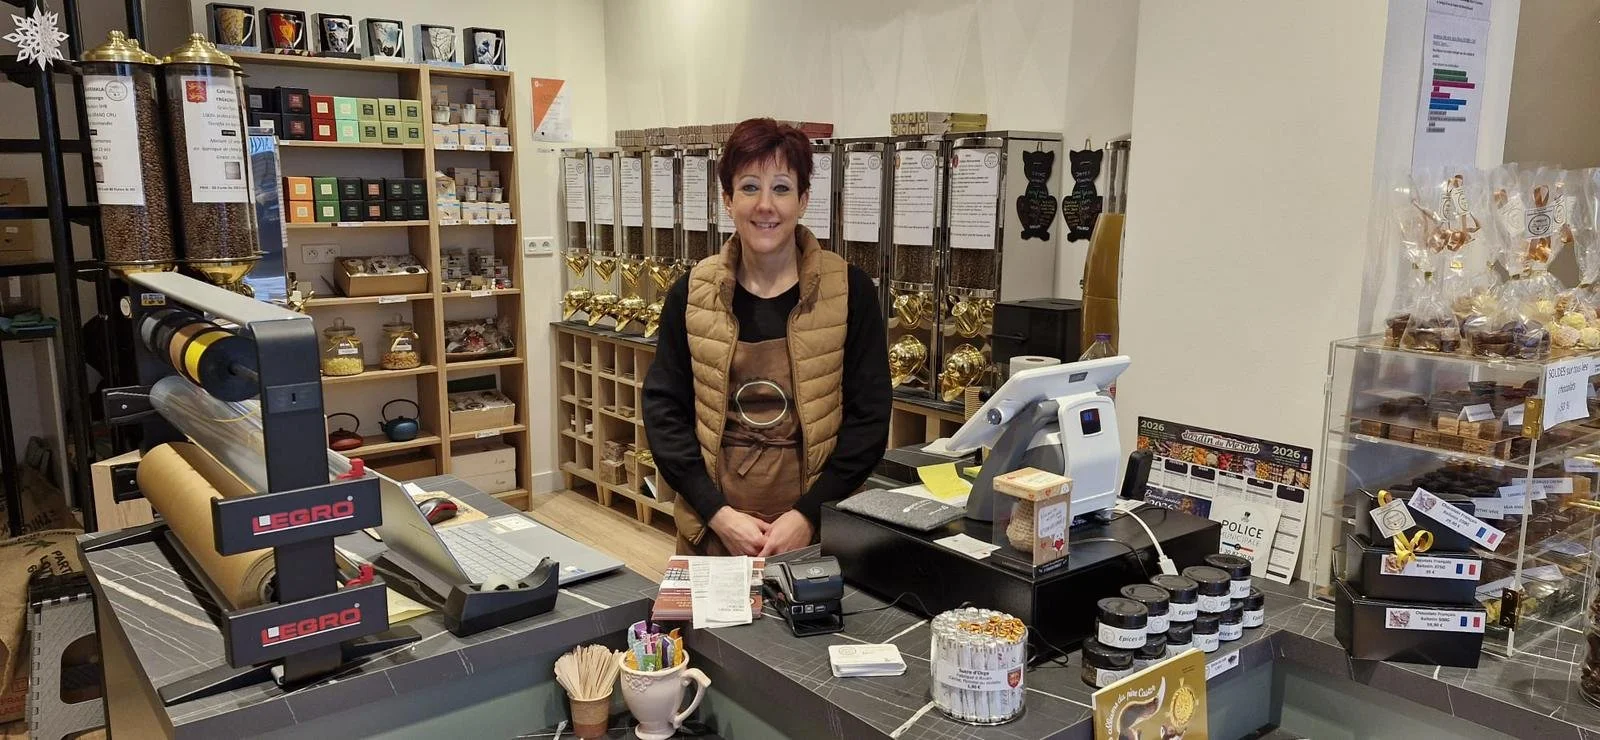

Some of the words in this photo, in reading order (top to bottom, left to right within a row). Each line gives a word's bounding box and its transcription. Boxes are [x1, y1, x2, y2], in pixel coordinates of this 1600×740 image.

[1140, 420, 1165, 432] 2026
[1182, 430, 1213, 444] Jardin
[1214, 438, 1224, 446] du
[1271, 445, 1301, 459] 2026
[252, 500, 355, 533] LEGRO
[1221, 519, 1264, 539] POLICE
[261, 607, 362, 645] LEGRO
[1118, 635, 1137, 643] Epices
